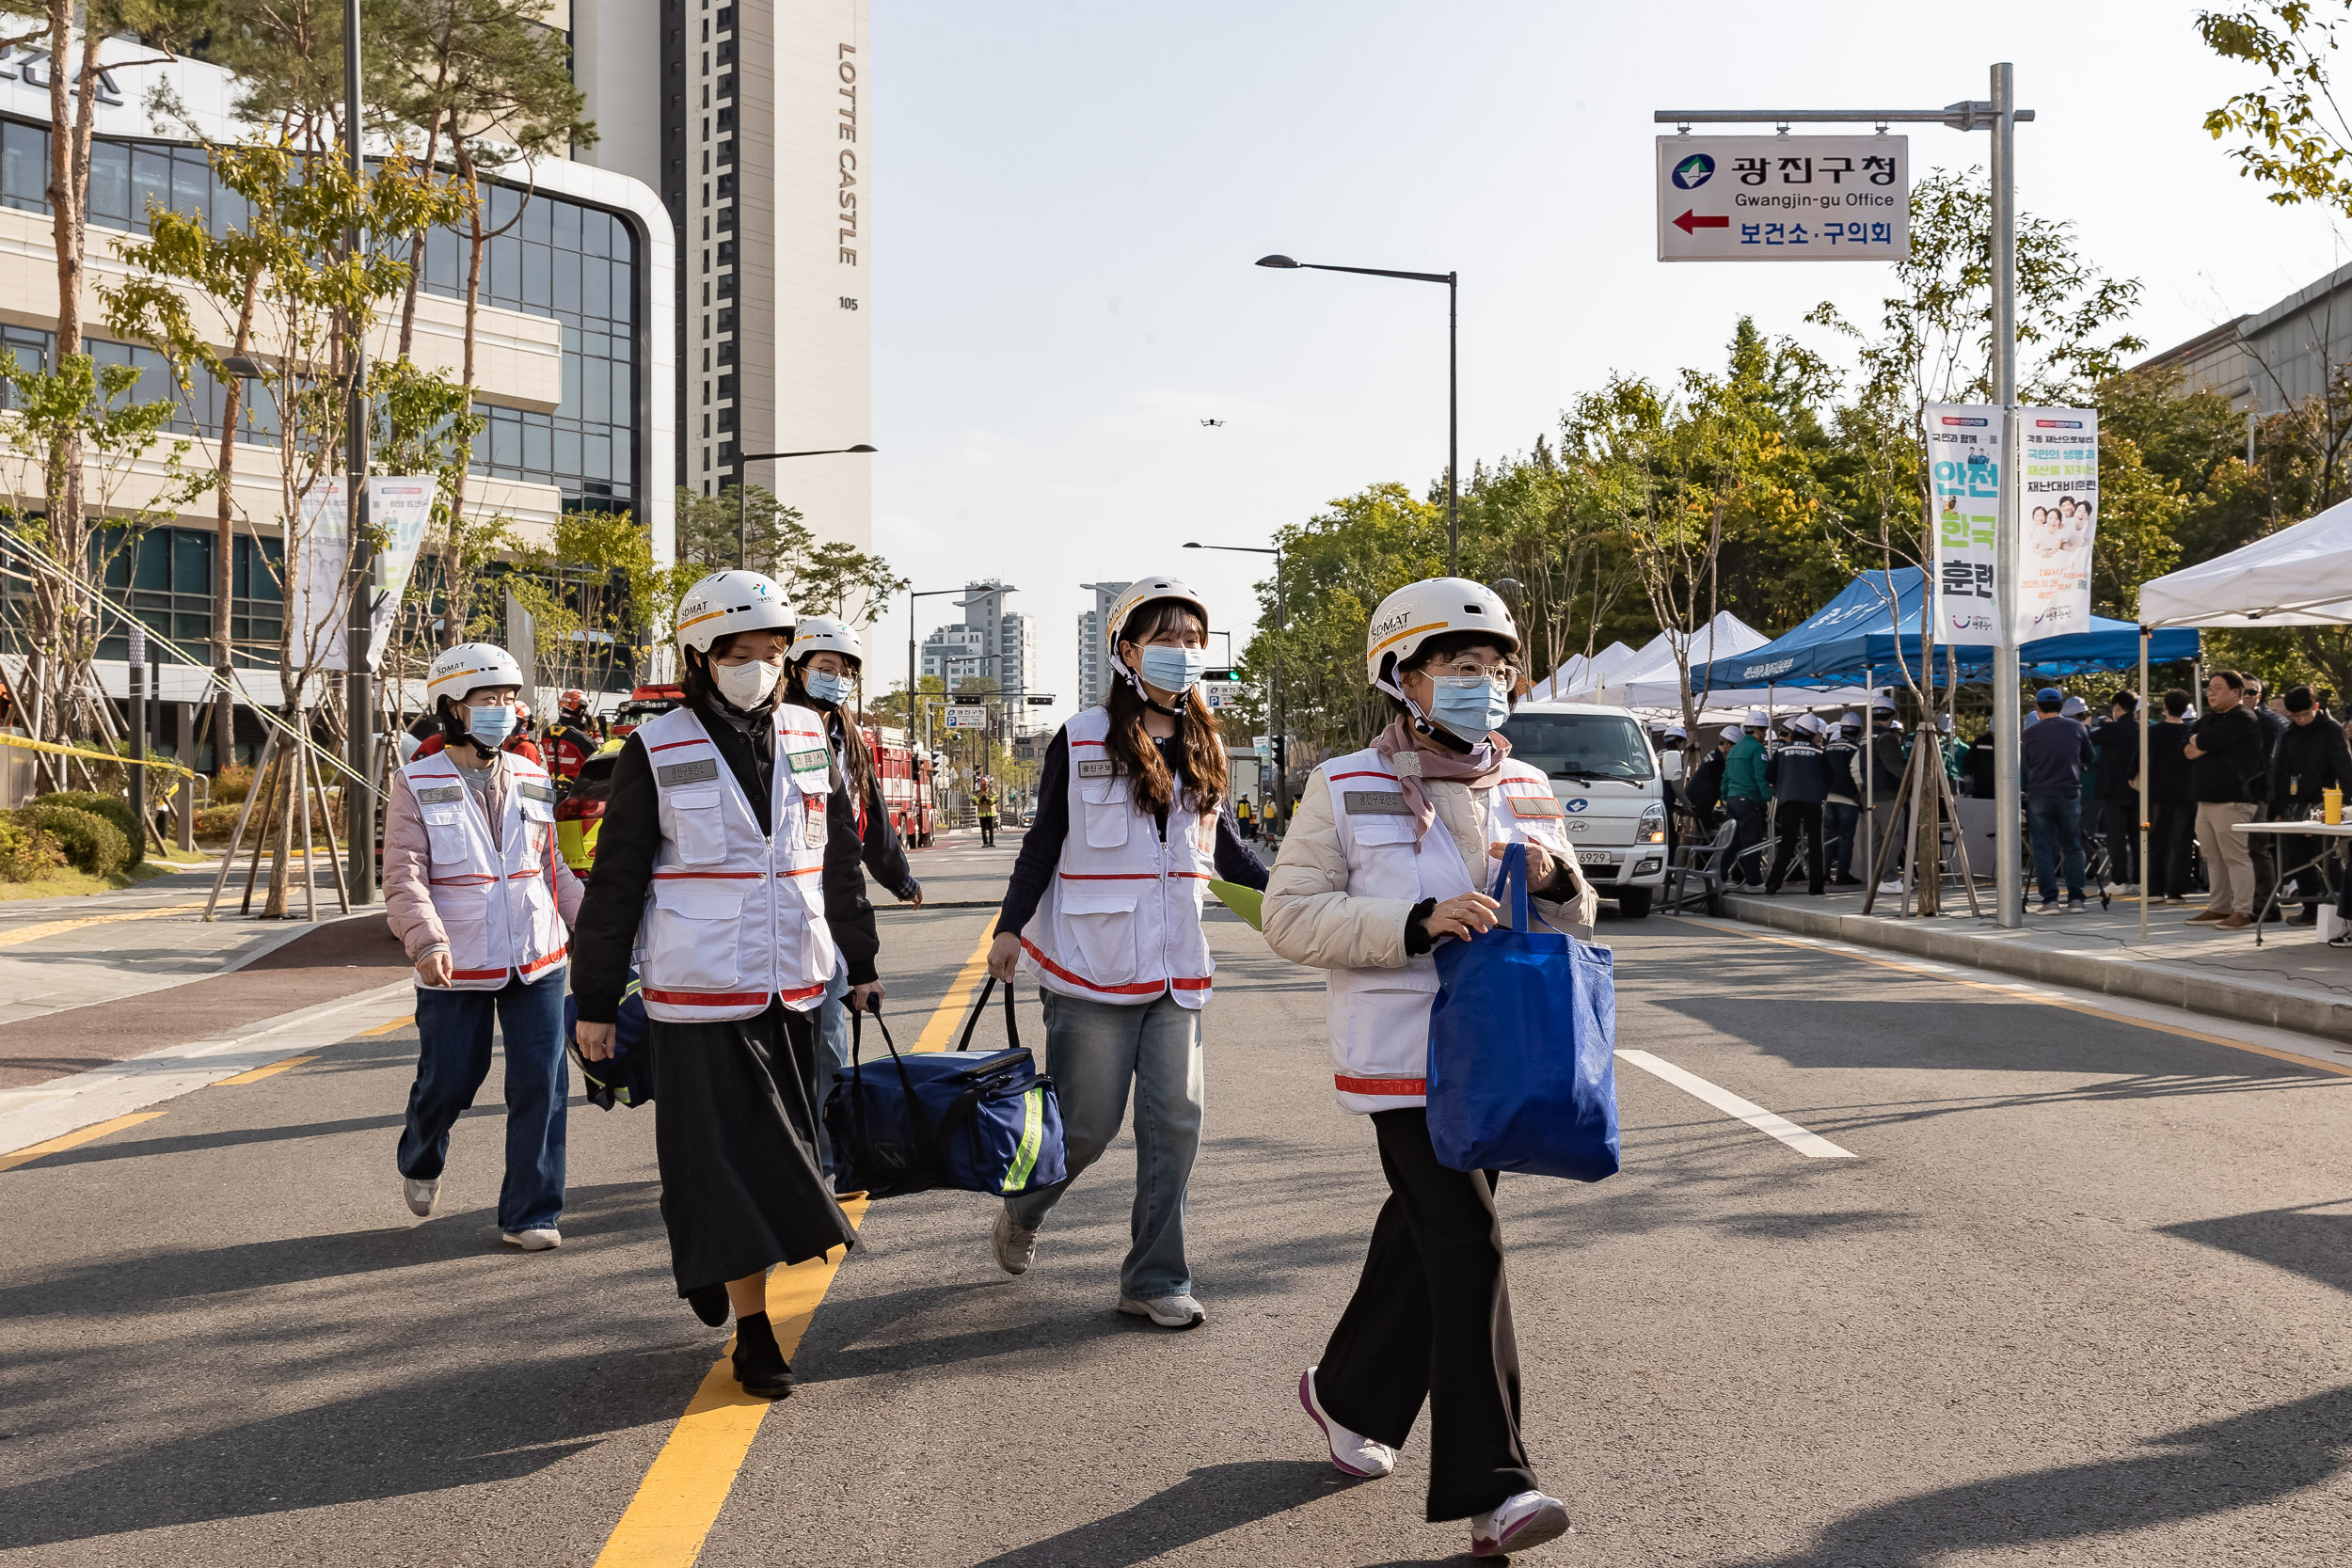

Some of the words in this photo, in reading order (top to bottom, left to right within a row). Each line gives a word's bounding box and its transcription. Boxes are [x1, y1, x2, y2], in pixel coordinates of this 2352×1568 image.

[0, 38, 124, 107] 건소
[839, 42, 856, 143] LOTTE
[1732, 156, 1897, 186] 광진구청
[839, 149, 857, 266] CASTLE
[1735, 193, 1840, 209] Gwangjin-gu
[1846, 192, 1895, 207] Office
[1740, 222, 1892, 245] 보건소·구의회
[838, 295, 858, 311] 105
[1931, 433, 1958, 444] 국민과
[1960, 434, 1978, 444] 함께
[2026, 435, 2043, 444] 각종
[2026, 449, 2060, 460] 국민의
[2063, 449, 2096, 460] 생명과
[2026, 465, 2060, 476] 재산을
[2063, 465, 2096, 475] 지키는
[1934, 461, 1998, 499] 안전
[2027, 481, 2097, 493] 재난대비훈련
[1940, 513, 1996, 550] 한국
[1942, 560, 1994, 599] 훈련
[671, 764, 705, 779] 광진구보건소
[1082, 764, 1117, 773] 광진구보
[1359, 793, 1399, 806] 광진구보건소
[1580, 852, 1606, 863] 6929
